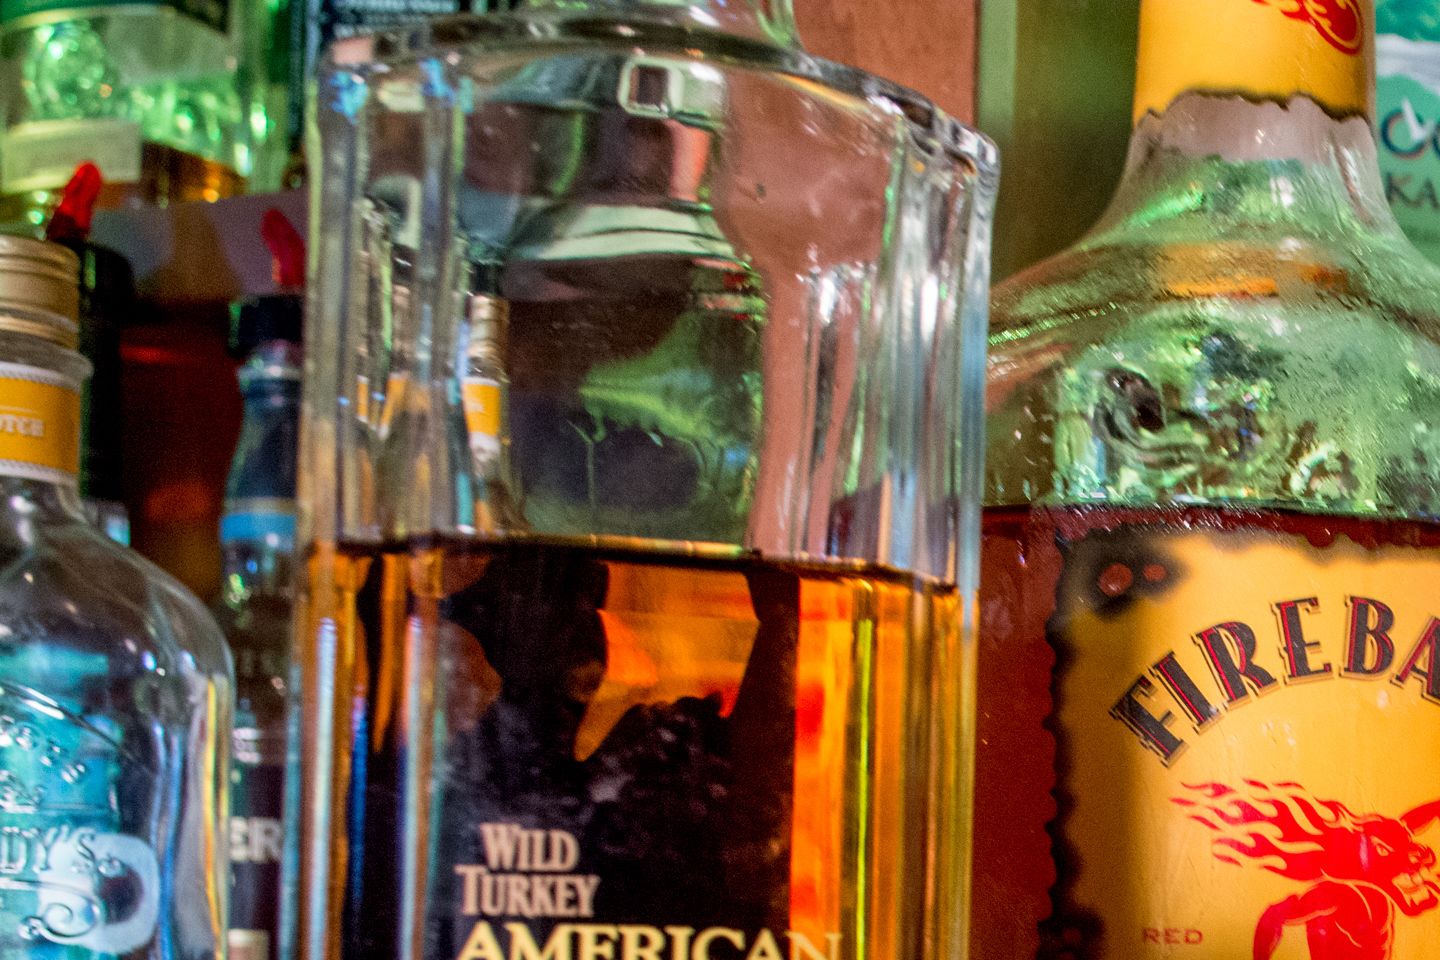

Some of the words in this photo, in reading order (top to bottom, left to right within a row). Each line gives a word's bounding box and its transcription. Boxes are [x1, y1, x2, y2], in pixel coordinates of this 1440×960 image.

[480, 822, 580, 872] WILD
[455, 866, 601, 918] TURKEY
[1142, 927, 1204, 946] RED
